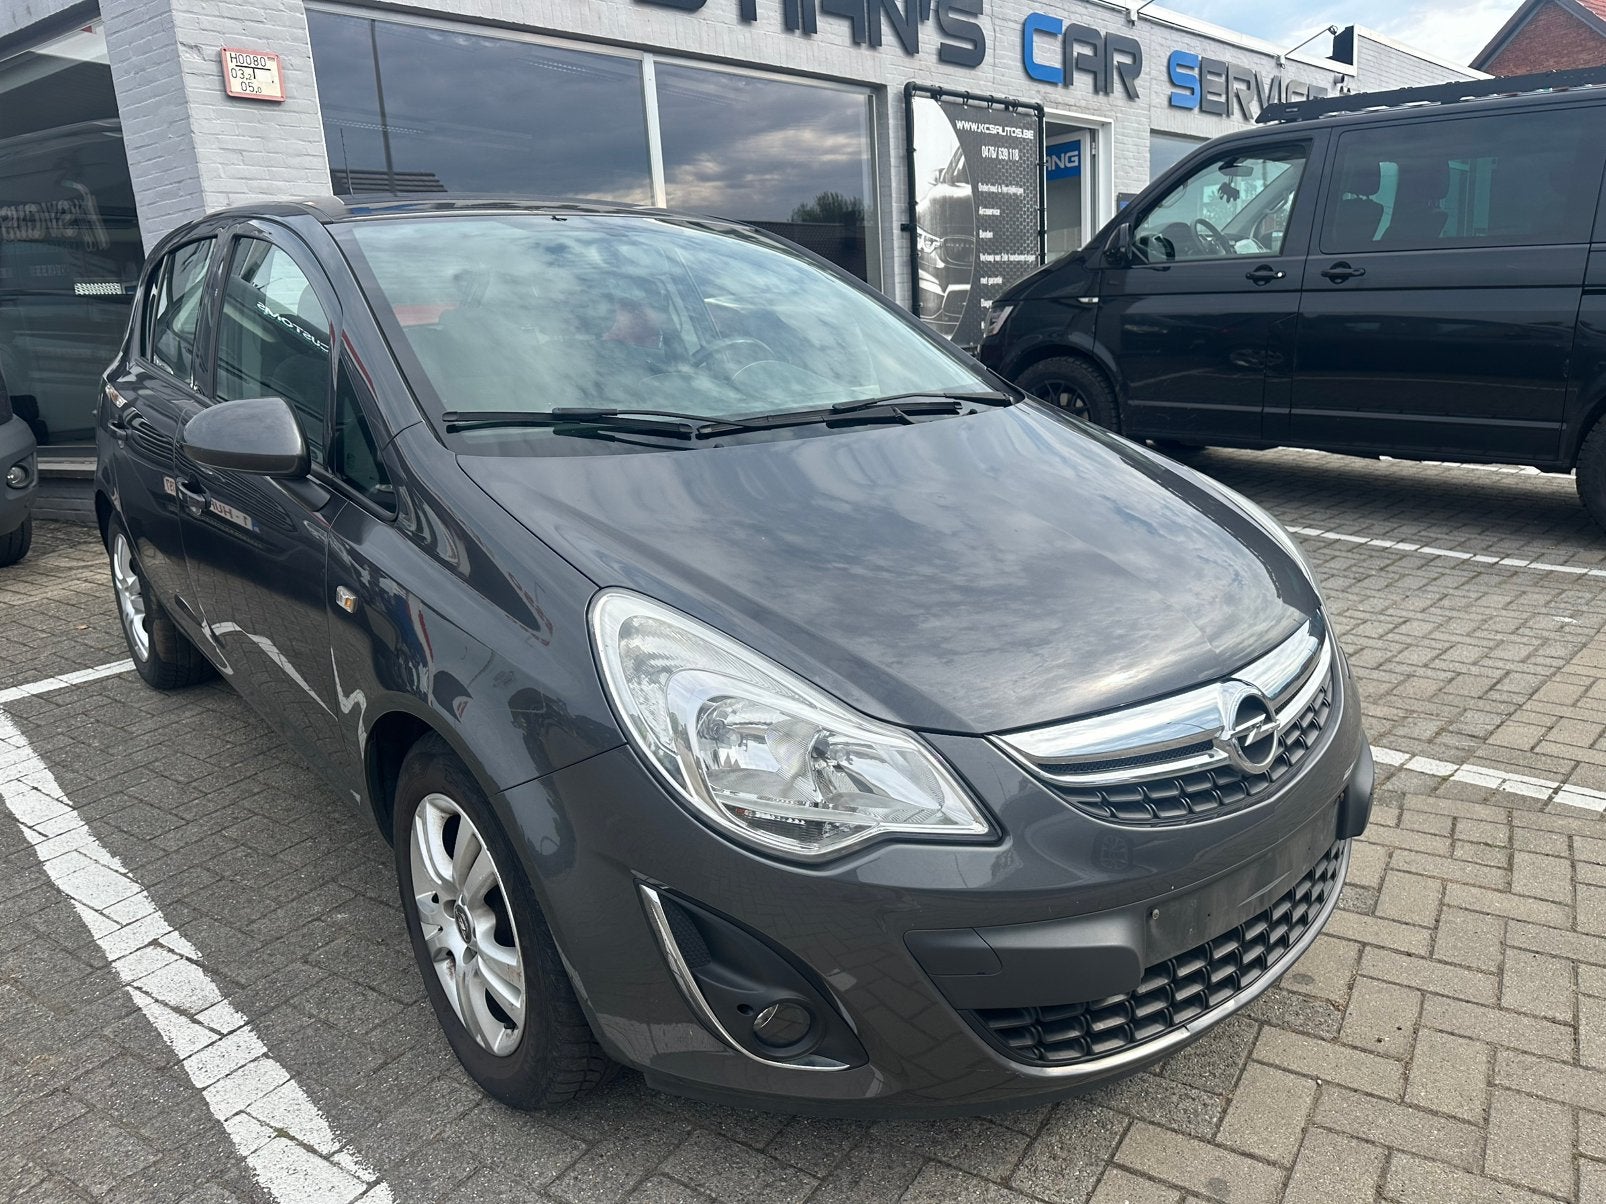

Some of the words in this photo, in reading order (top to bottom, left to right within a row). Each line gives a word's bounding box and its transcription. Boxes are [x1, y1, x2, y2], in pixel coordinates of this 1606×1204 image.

[229, 53, 266, 67] H0080
[1023, 12, 1143, 100] CAR
[956, 120, 1034, 139] WWW.KCSAUTOS.BE
